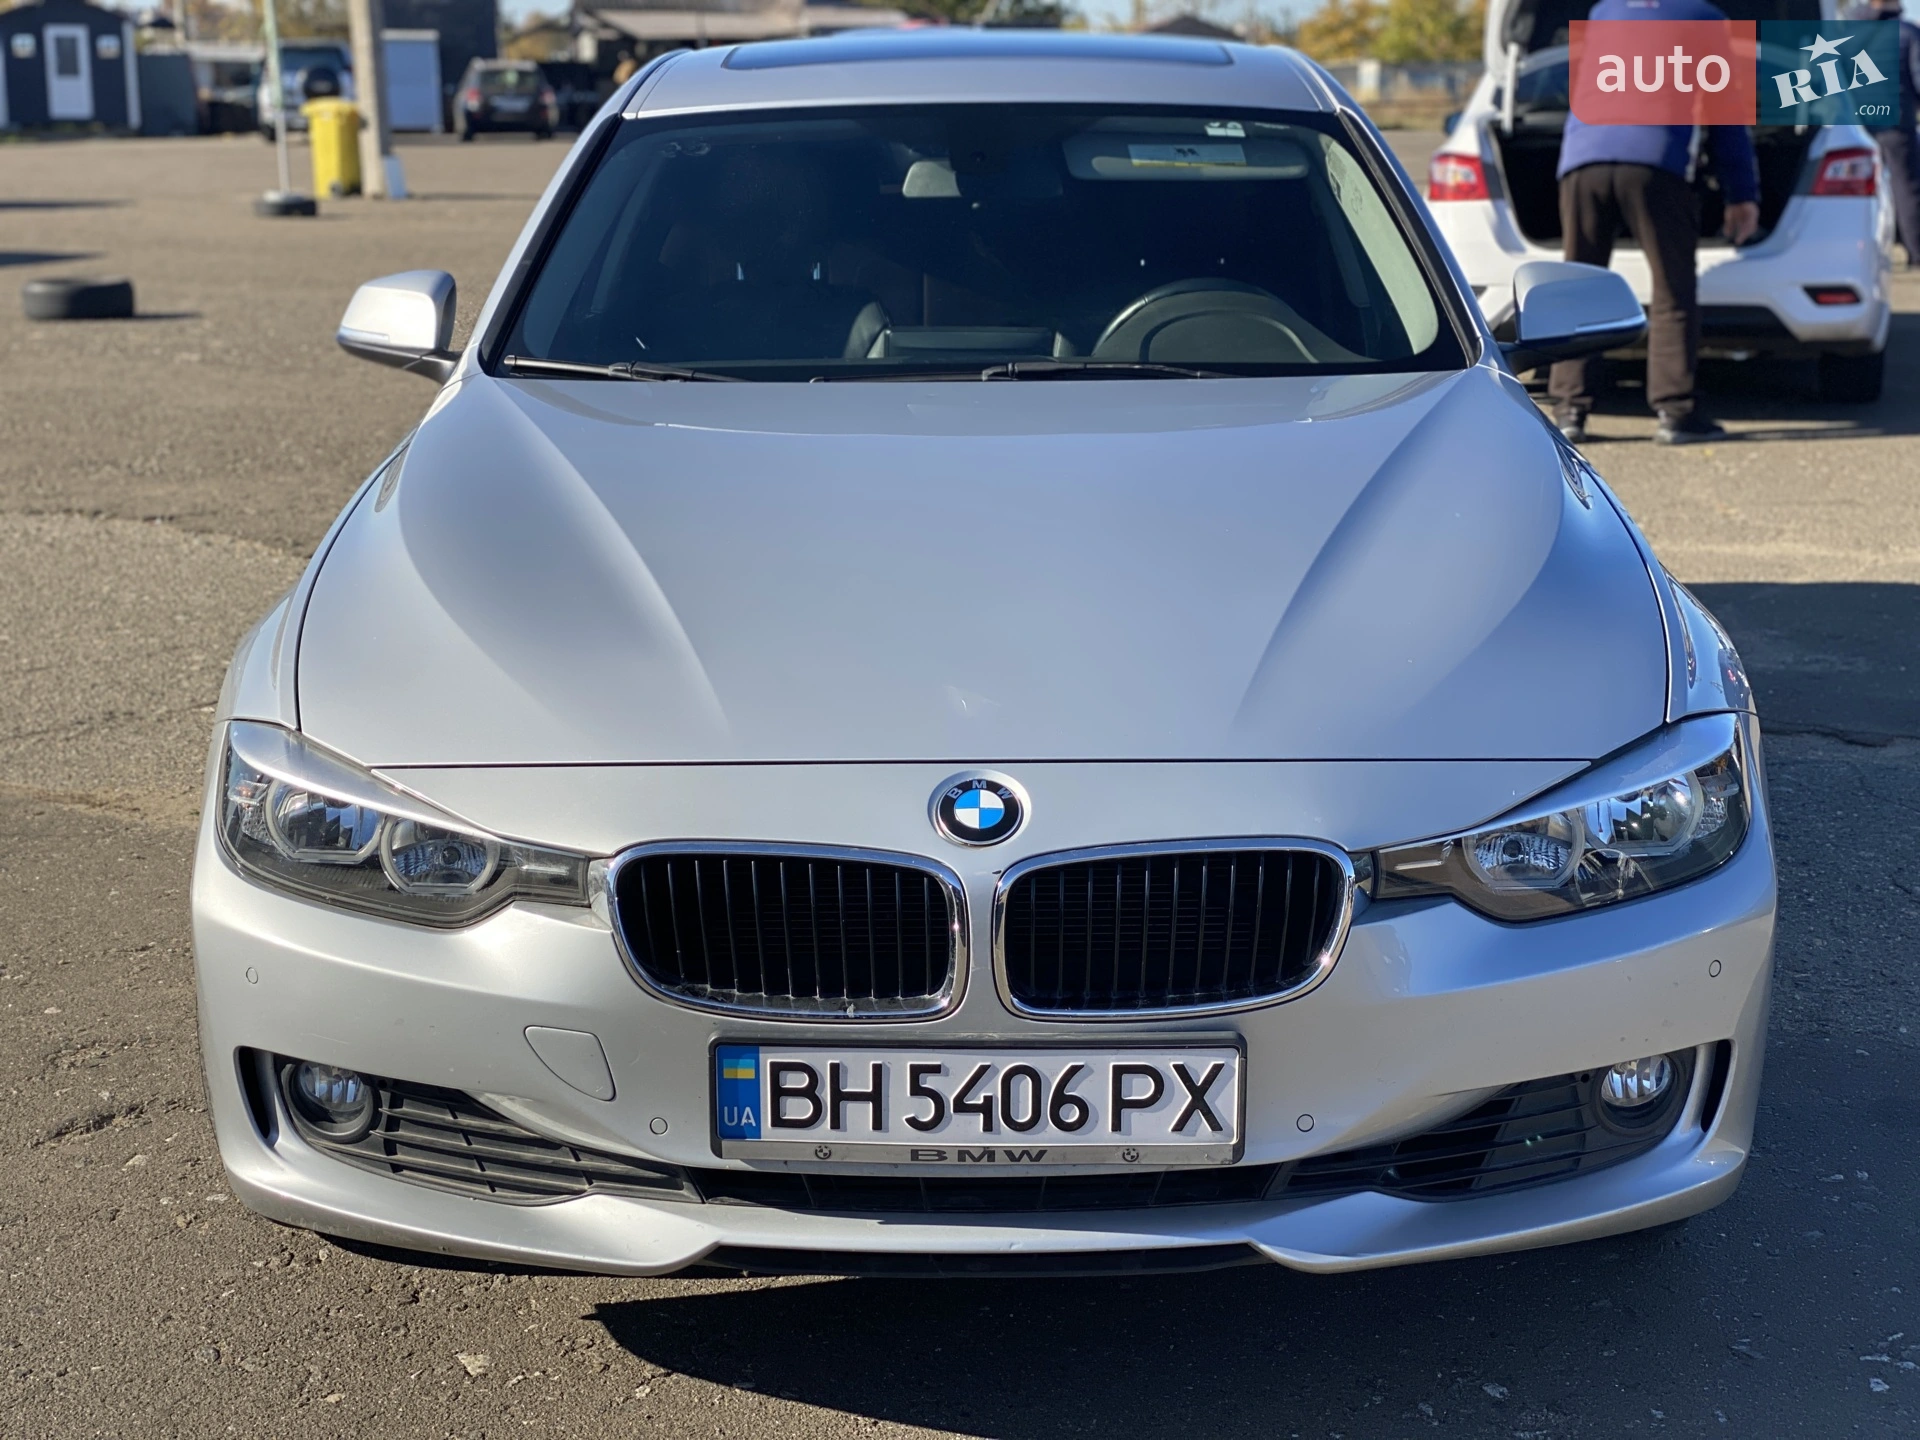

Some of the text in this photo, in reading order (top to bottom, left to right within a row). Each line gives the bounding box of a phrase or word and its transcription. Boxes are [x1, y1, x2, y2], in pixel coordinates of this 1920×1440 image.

[947, 780, 1013, 799] BMW
[768, 1061, 1225, 1132] BH 5406 PX
[724, 1106, 756, 1127] UA
[910, 1148, 1049, 1163] BMW
